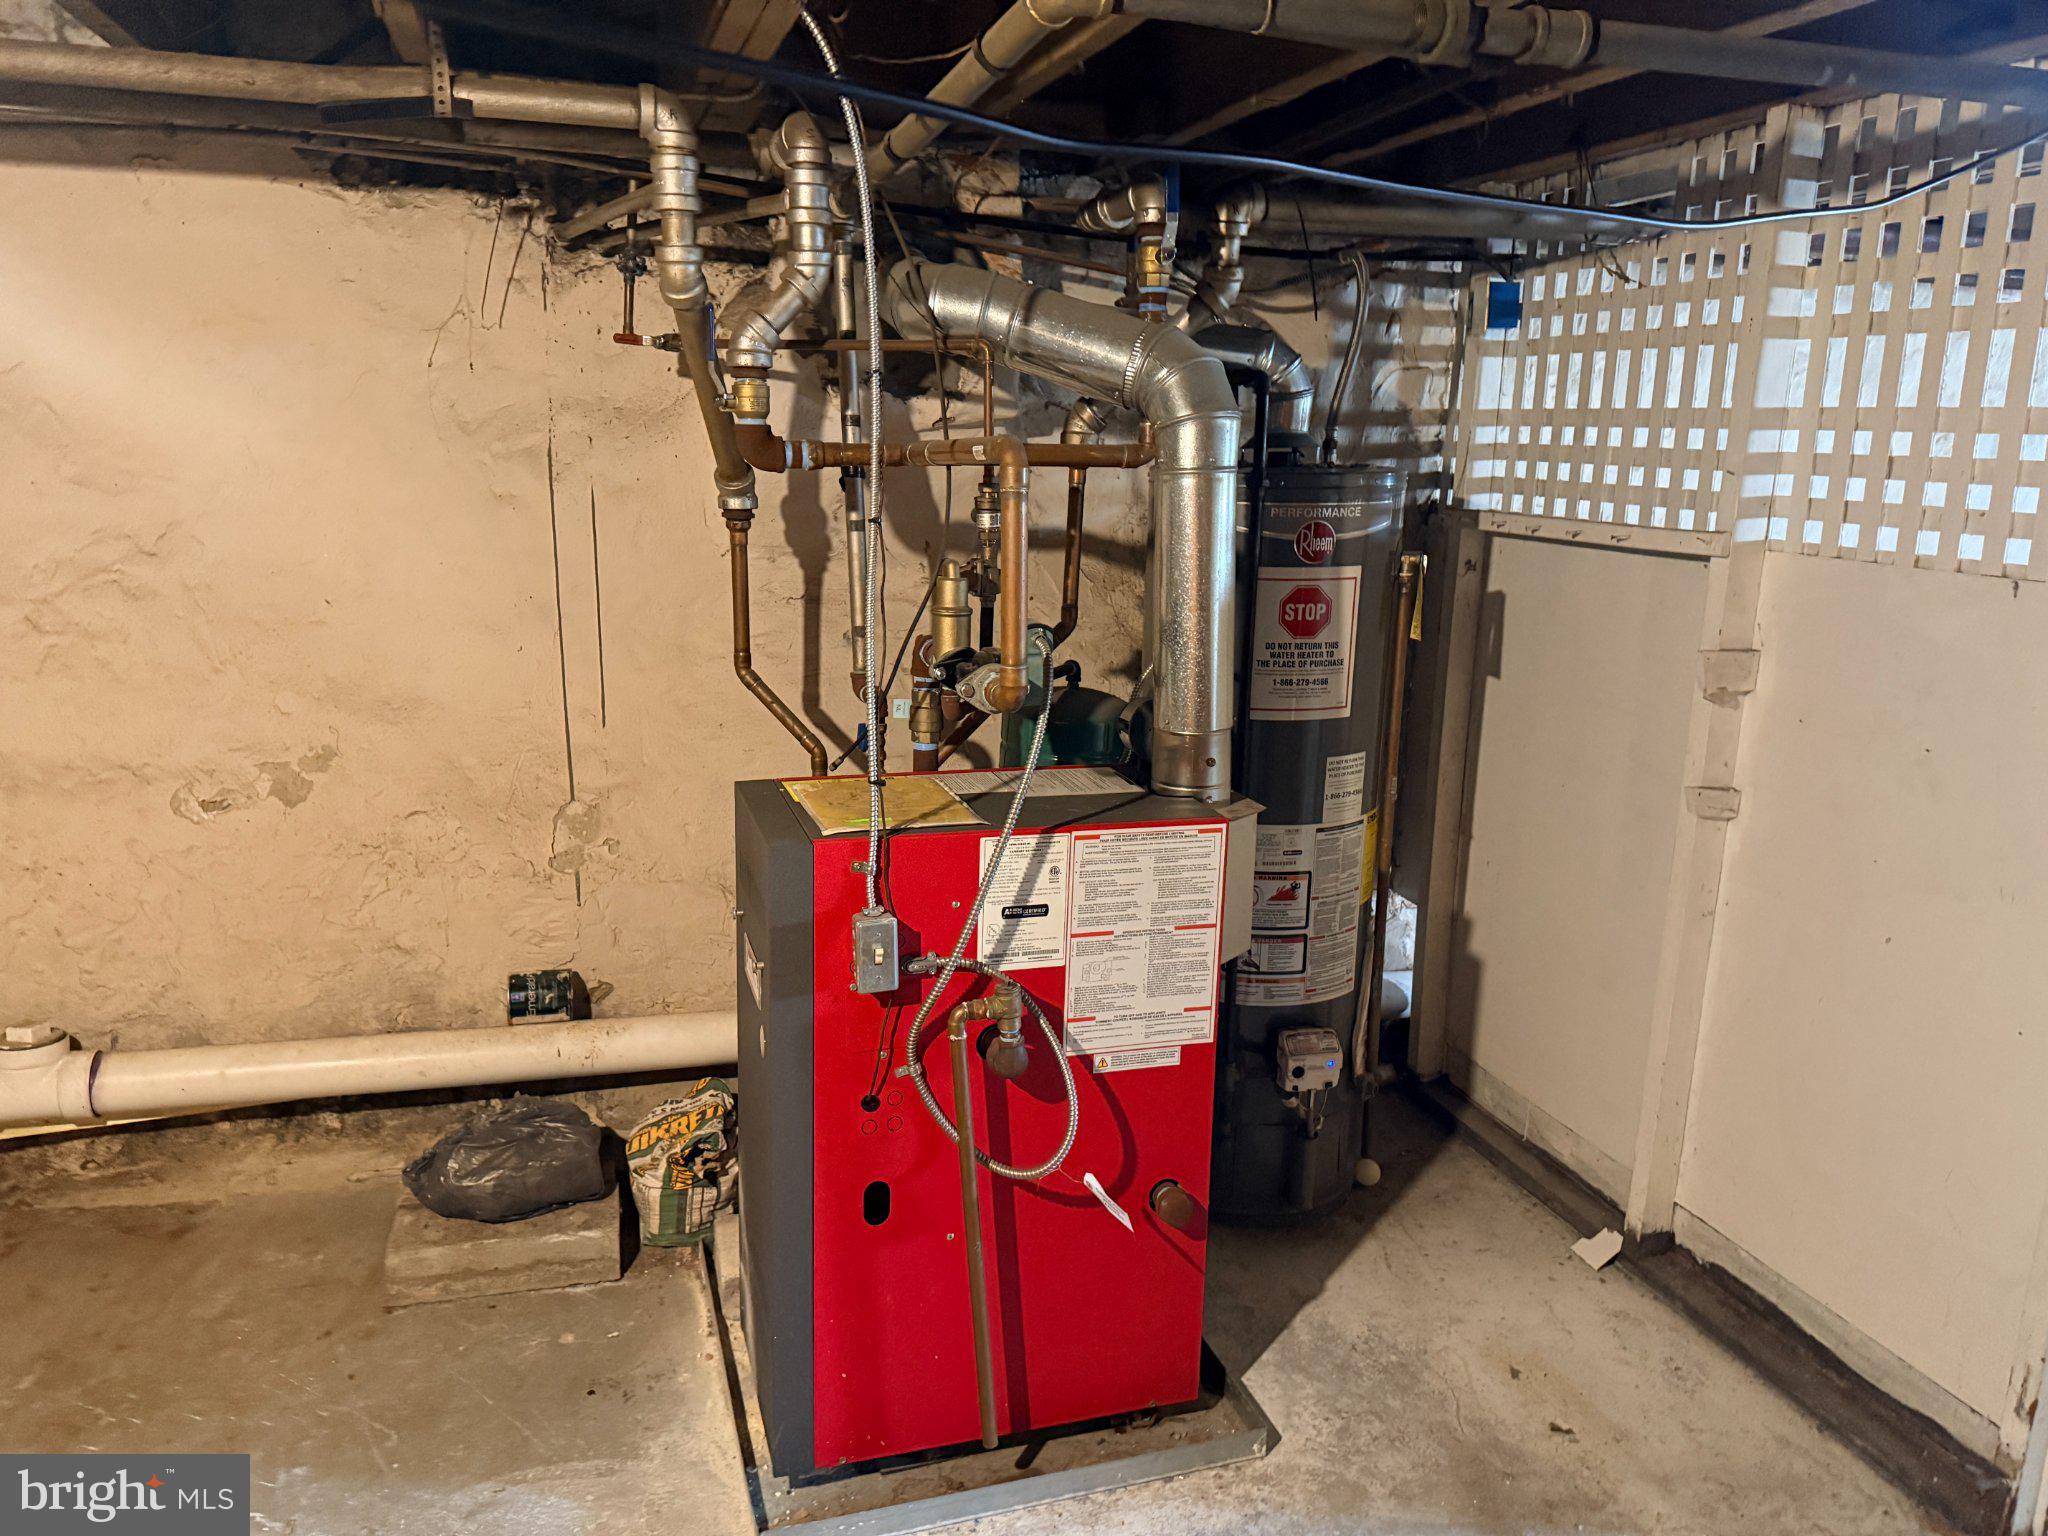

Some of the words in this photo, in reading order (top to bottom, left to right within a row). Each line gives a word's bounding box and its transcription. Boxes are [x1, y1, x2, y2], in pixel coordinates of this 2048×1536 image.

[1270, 506, 1362, 518] PERFORMANCE
[1299, 521, 1334, 557] Rheem
[1284, 603, 1327, 622] STOP
[1266, 642, 1276, 650] DO
[1278, 642, 1292, 650] NOT
[1294, 642, 1322, 650] RETURN
[1324, 641, 1340, 650] THIS
[1270, 651, 1297, 660] WATER
[1298, 651, 1324, 659] HEATER
[1273, 660, 1296, 668] PLACE
[1298, 660, 1308, 668] OF
[1310, 658, 1344, 668] PURCHASE
